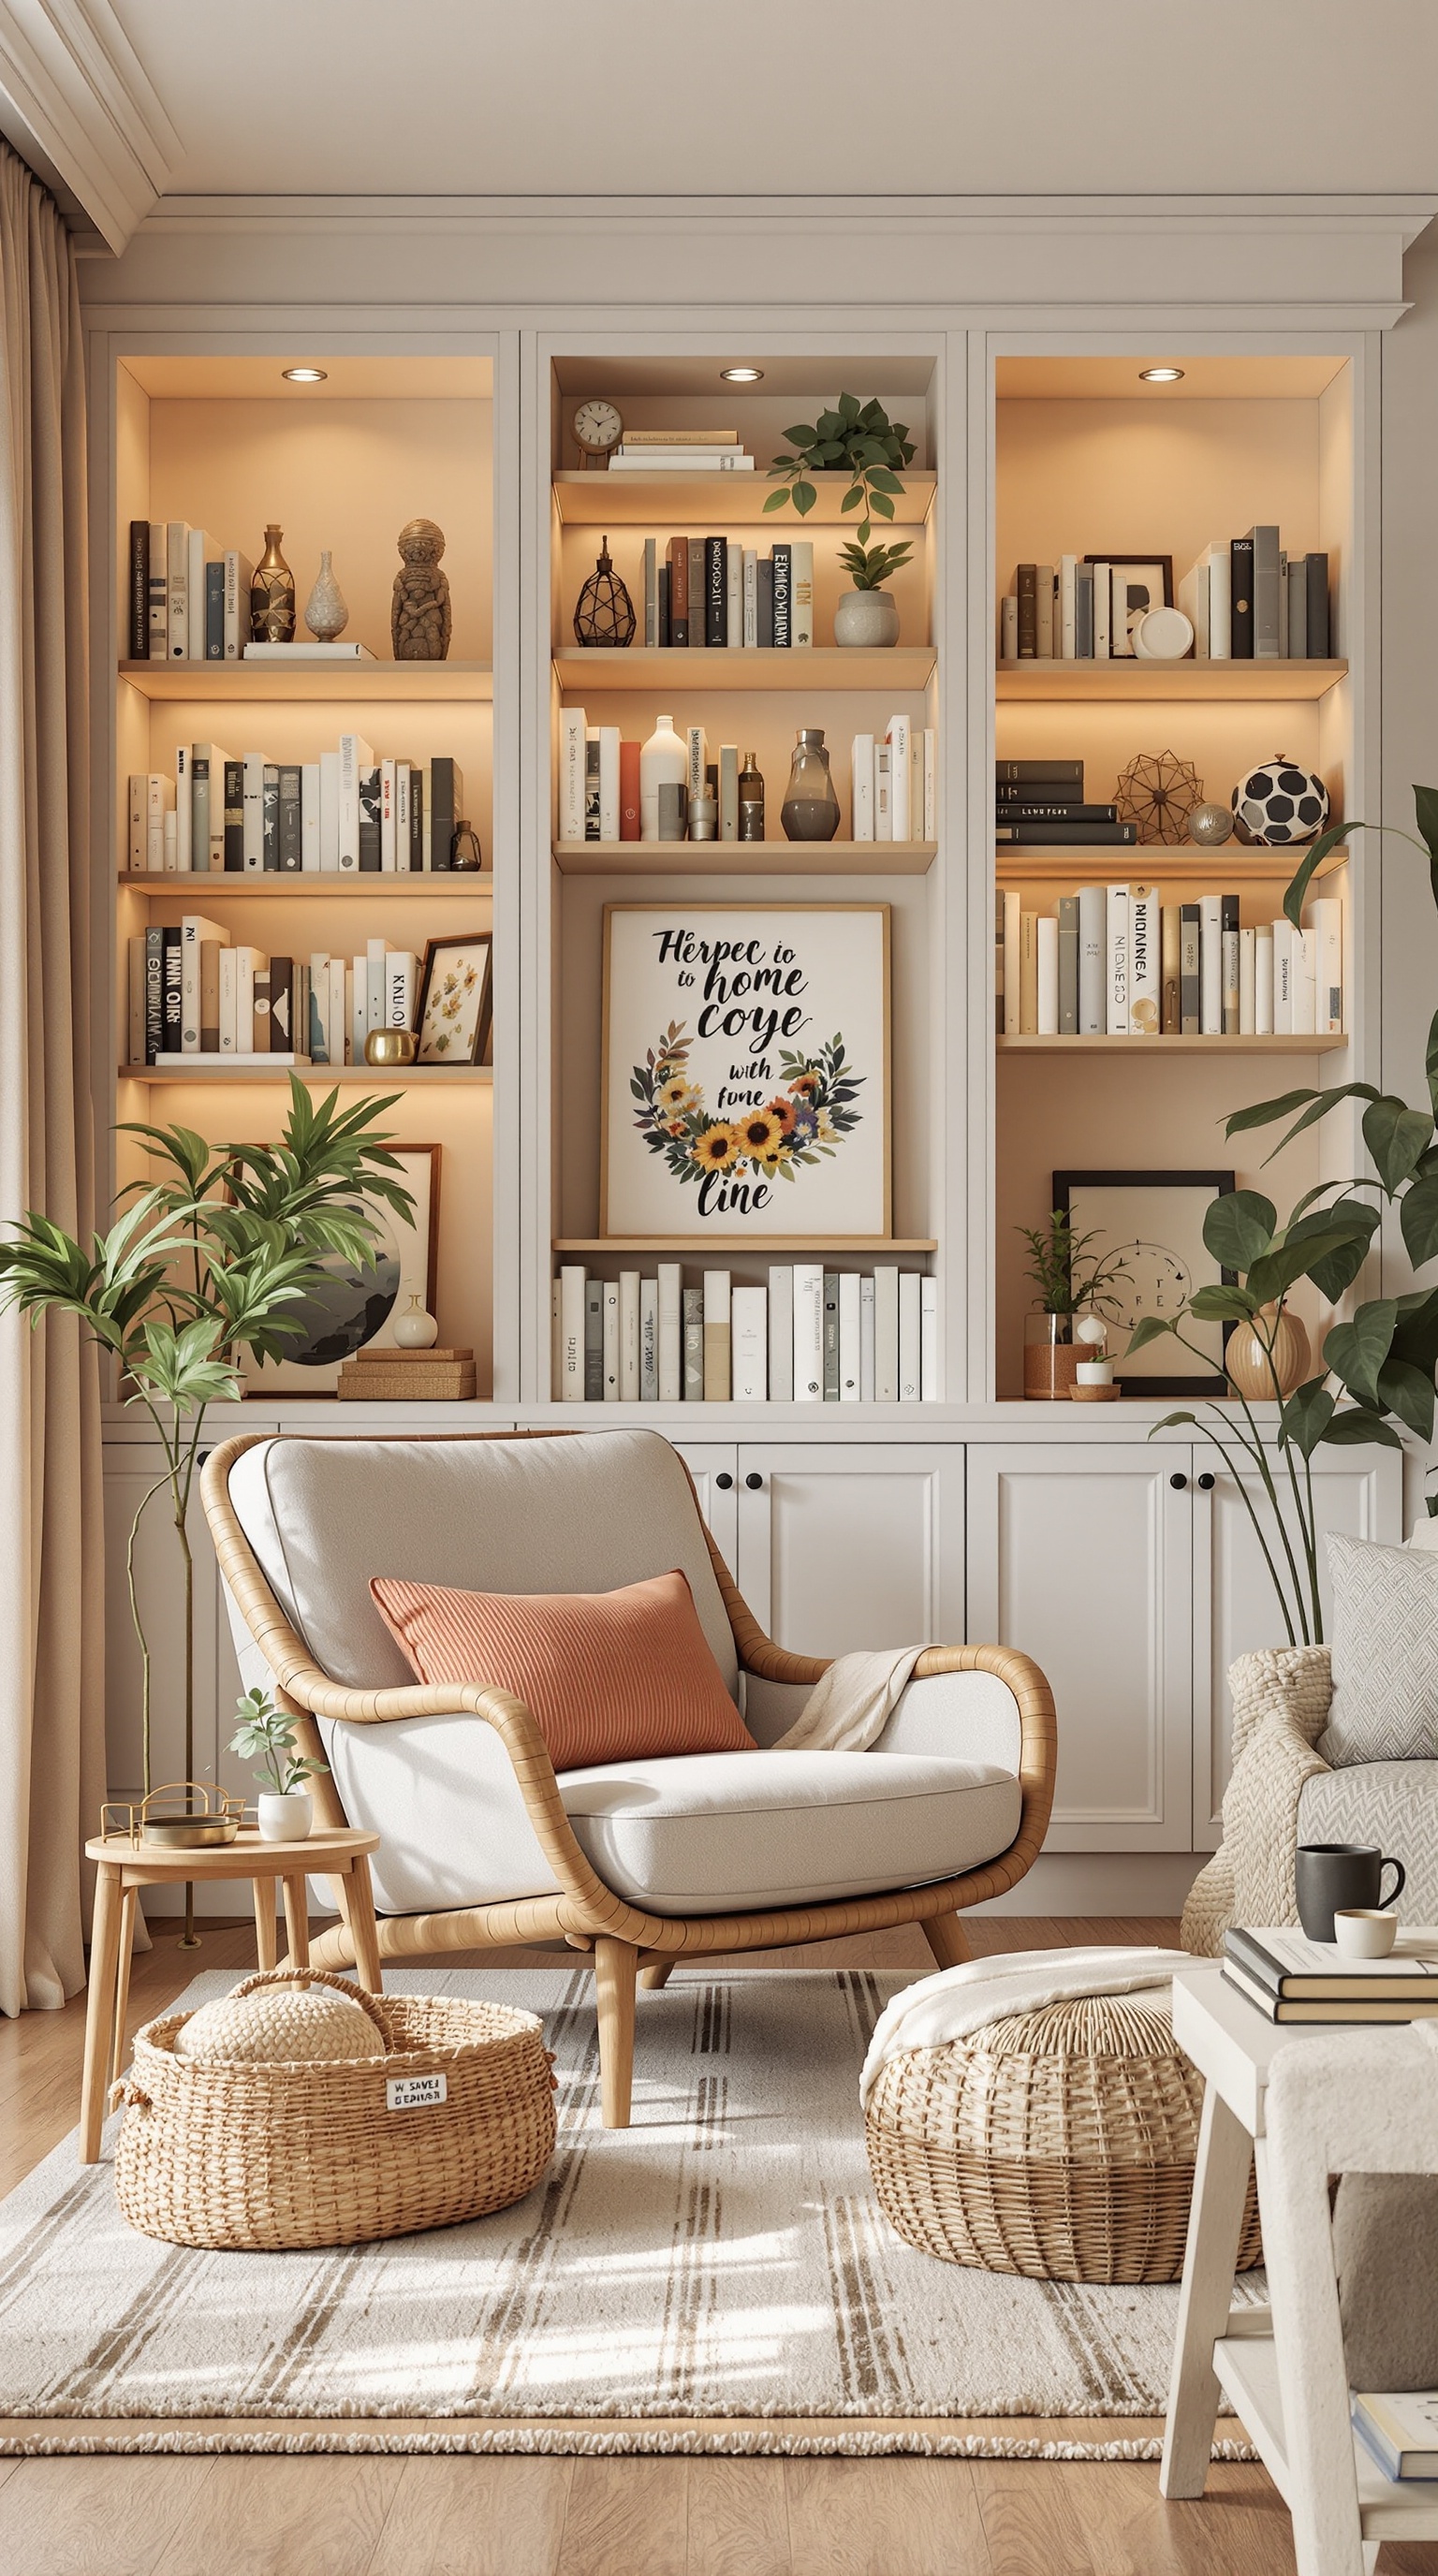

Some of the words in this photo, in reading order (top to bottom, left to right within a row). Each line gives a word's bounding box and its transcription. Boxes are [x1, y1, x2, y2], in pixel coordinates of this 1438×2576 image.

[703, 961, 810, 1004] home
[728, 1057, 774, 1080] with
[697, 1169, 774, 1217] line
